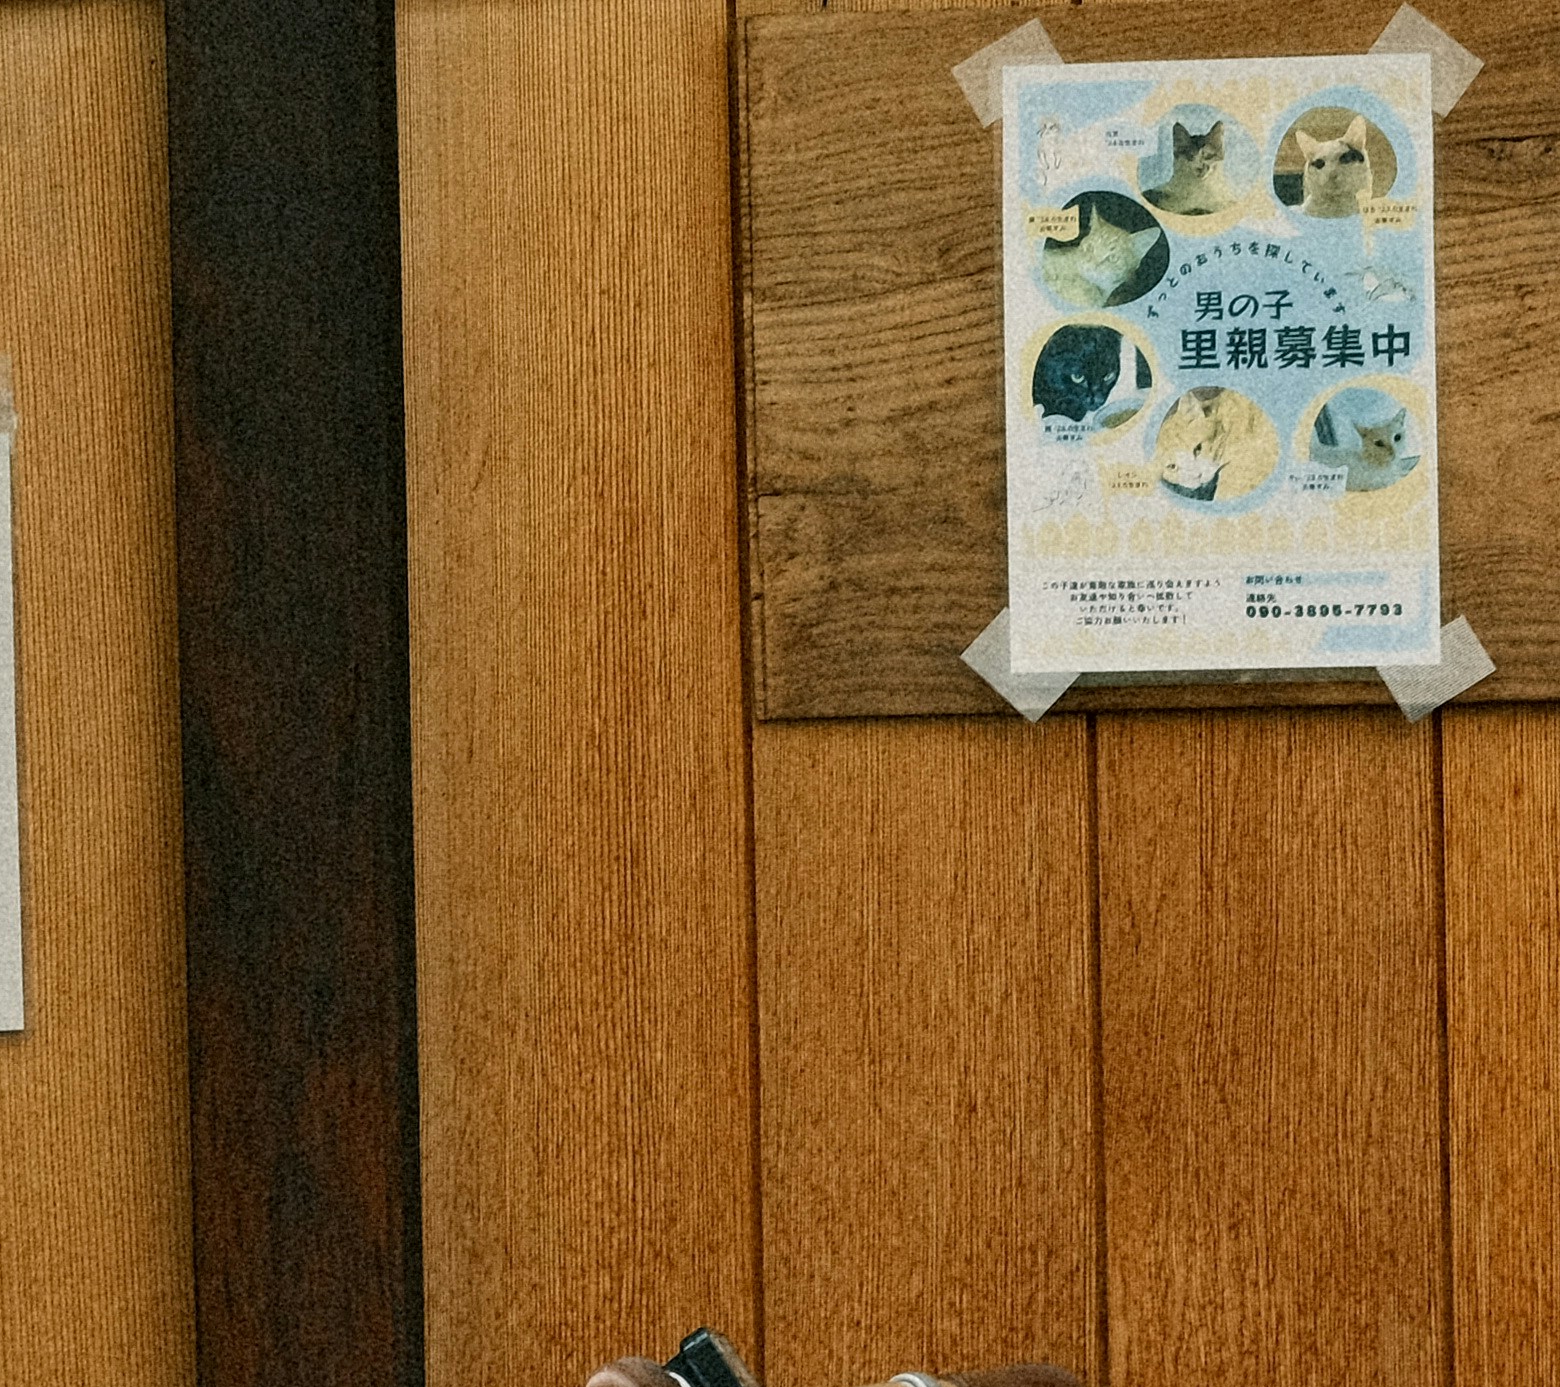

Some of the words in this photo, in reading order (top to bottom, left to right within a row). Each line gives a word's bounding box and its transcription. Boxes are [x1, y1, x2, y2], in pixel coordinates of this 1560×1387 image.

[1194, 289, 1293, 322] 男の子
[1178, 323, 1411, 370] 里親募集中
[1245, 574, 1302, 586] お問い合わせ
